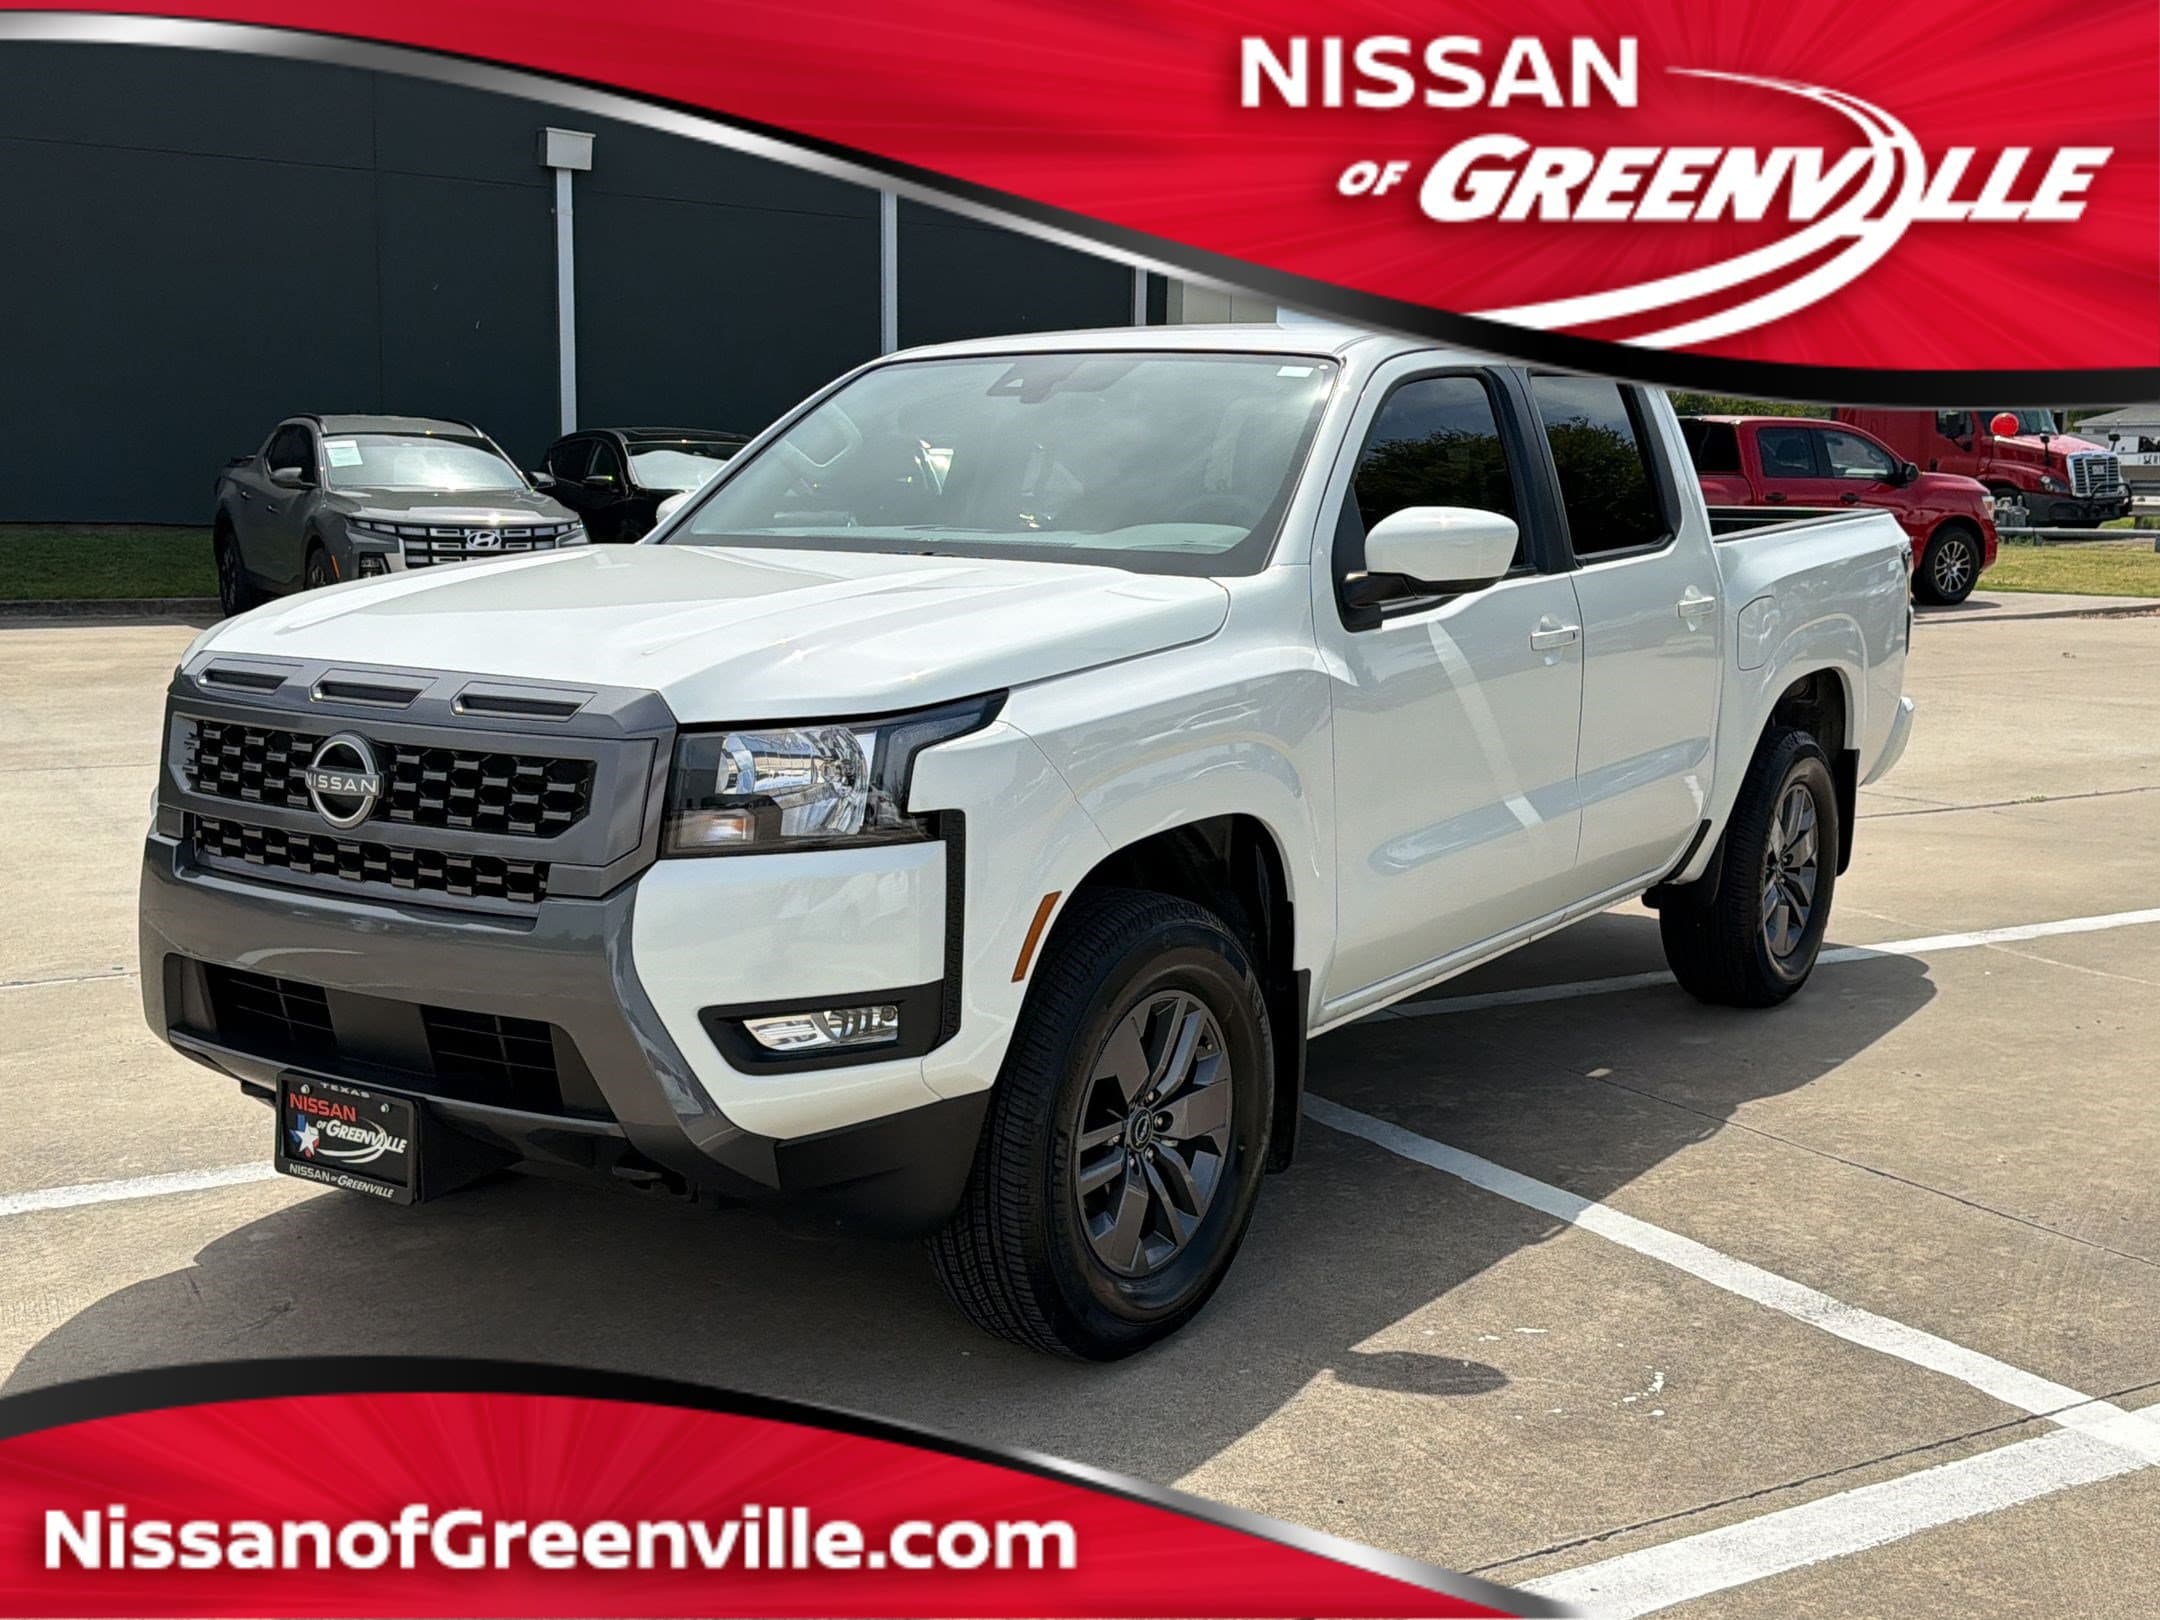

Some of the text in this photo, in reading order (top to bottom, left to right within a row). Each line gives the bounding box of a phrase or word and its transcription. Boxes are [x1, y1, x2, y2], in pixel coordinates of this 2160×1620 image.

[305, 771, 377, 793] NISSAN
[320, 1081, 370, 1099] TEXAS
[289, 1092, 357, 1122] NISSAN
[326, 1119, 408, 1155] GREENVILLE
[289, 1163, 331, 1182] NISSAN
[337, 1174, 394, 1199] GREENVILLE
